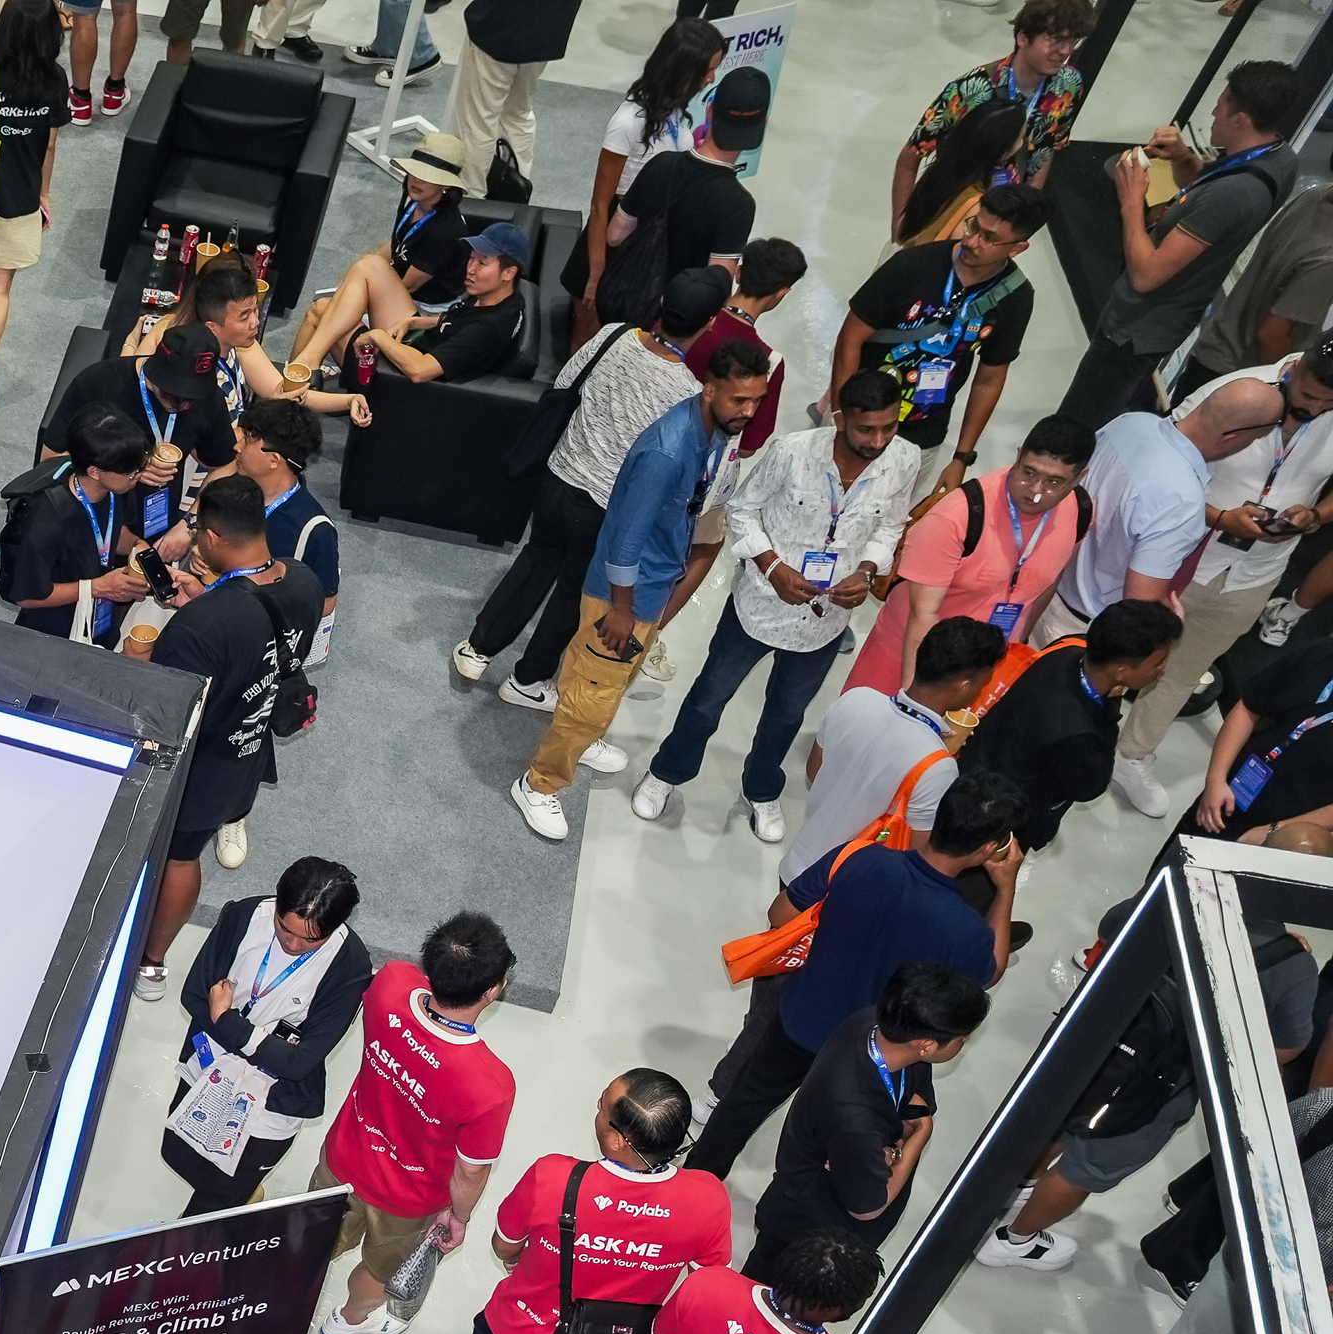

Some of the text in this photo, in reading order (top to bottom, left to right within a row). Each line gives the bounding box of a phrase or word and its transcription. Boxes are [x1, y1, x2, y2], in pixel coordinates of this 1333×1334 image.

[736, 25, 784, 52] RICH,
[401, 1029, 441, 1070] Paylabs
[369, 1039, 426, 1099] ASK ME
[616, 1199, 671, 1218] Paylabs
[574, 1233, 663, 1258] ASK ME
[87, 1235, 282, 1289] MEXC Ventures
[108, 1311, 163, 1329] Rewards
[166, 1306, 185, 1318] for
[187, 1293, 245, 1312] Affiliates
[122, 1293, 190, 1314] MEXC Win:
[231, 1301, 268, 1321] the
